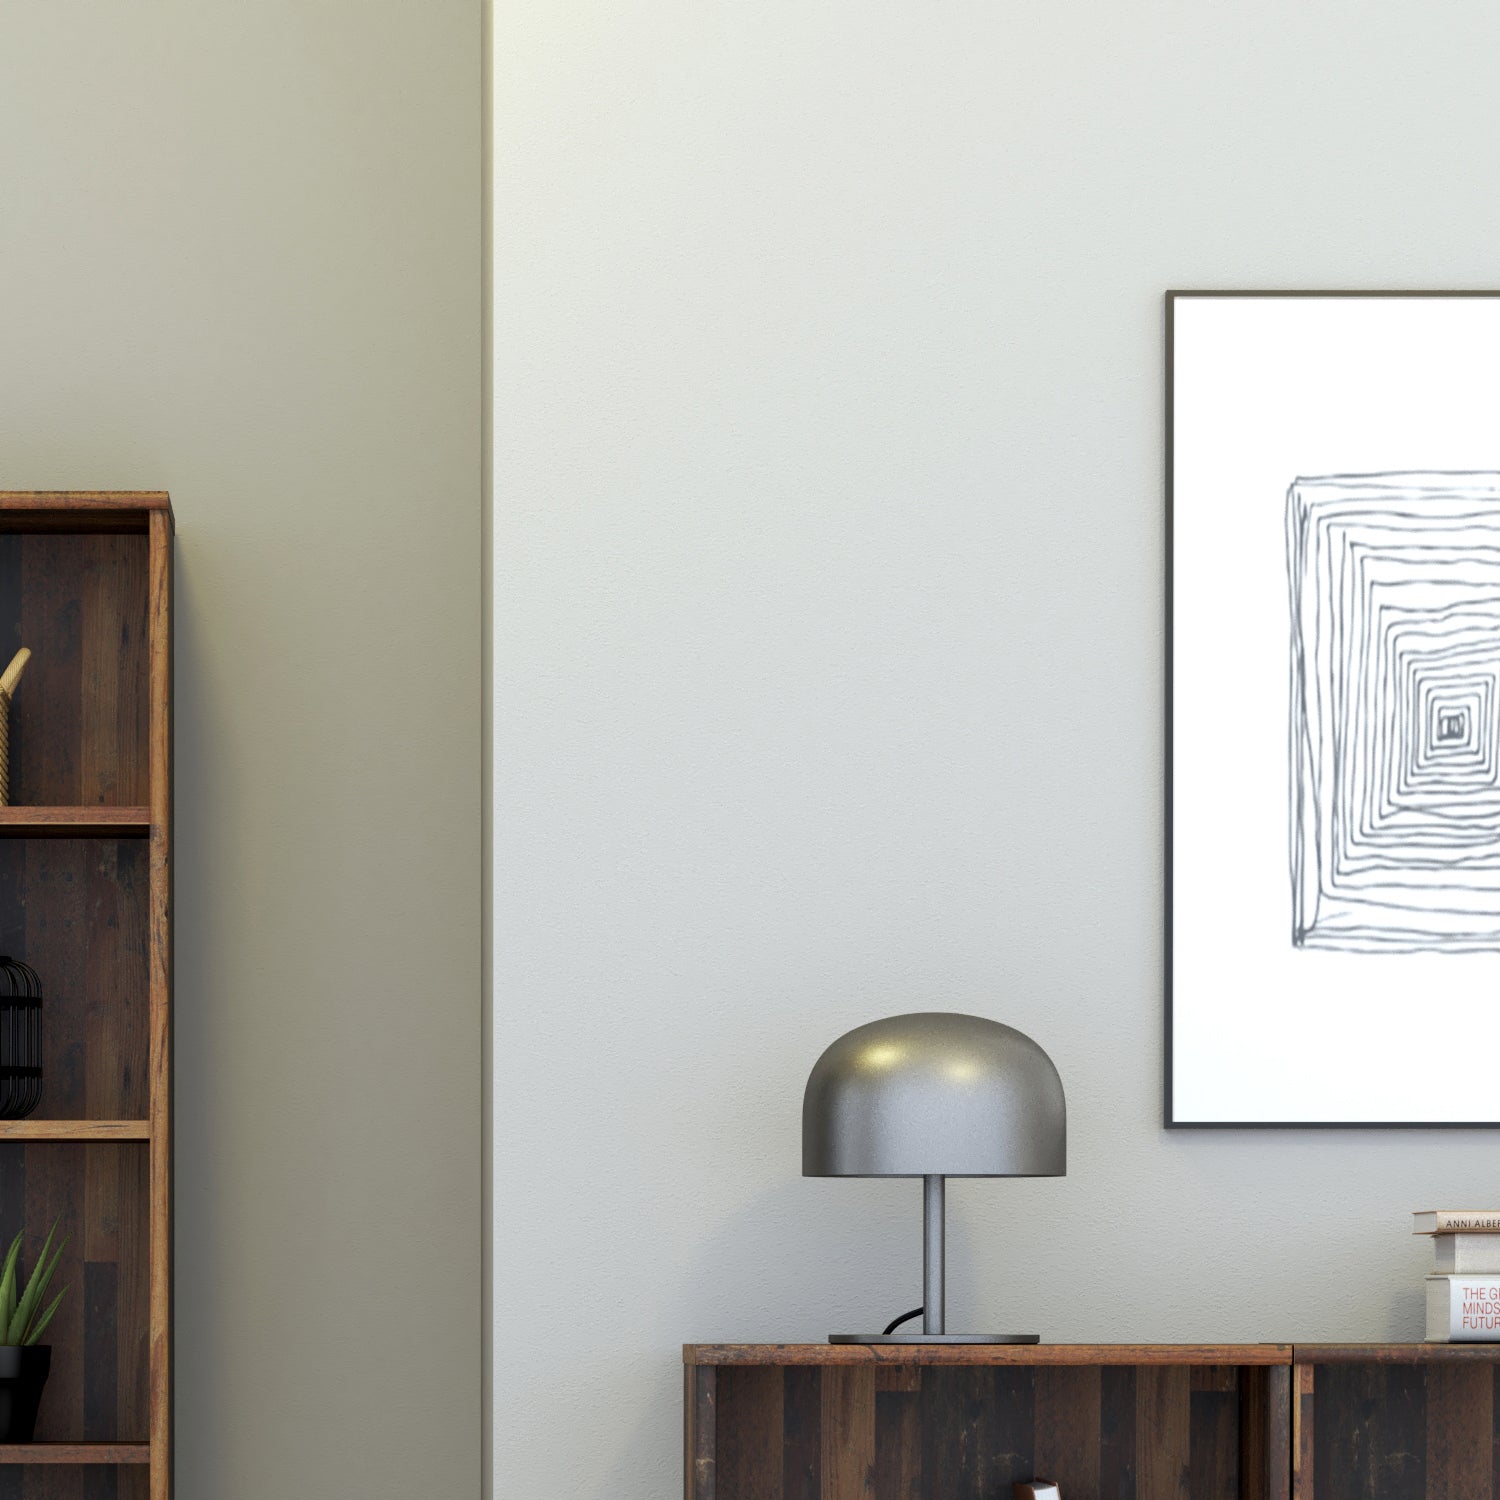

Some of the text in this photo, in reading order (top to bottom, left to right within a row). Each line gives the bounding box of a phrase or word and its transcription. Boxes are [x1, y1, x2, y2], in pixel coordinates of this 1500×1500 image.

[1446, 1219, 1471, 1228] ANNI
[1463, 1288, 1486, 1300] THE
[1463, 1302, 1500, 1315] MINDS
